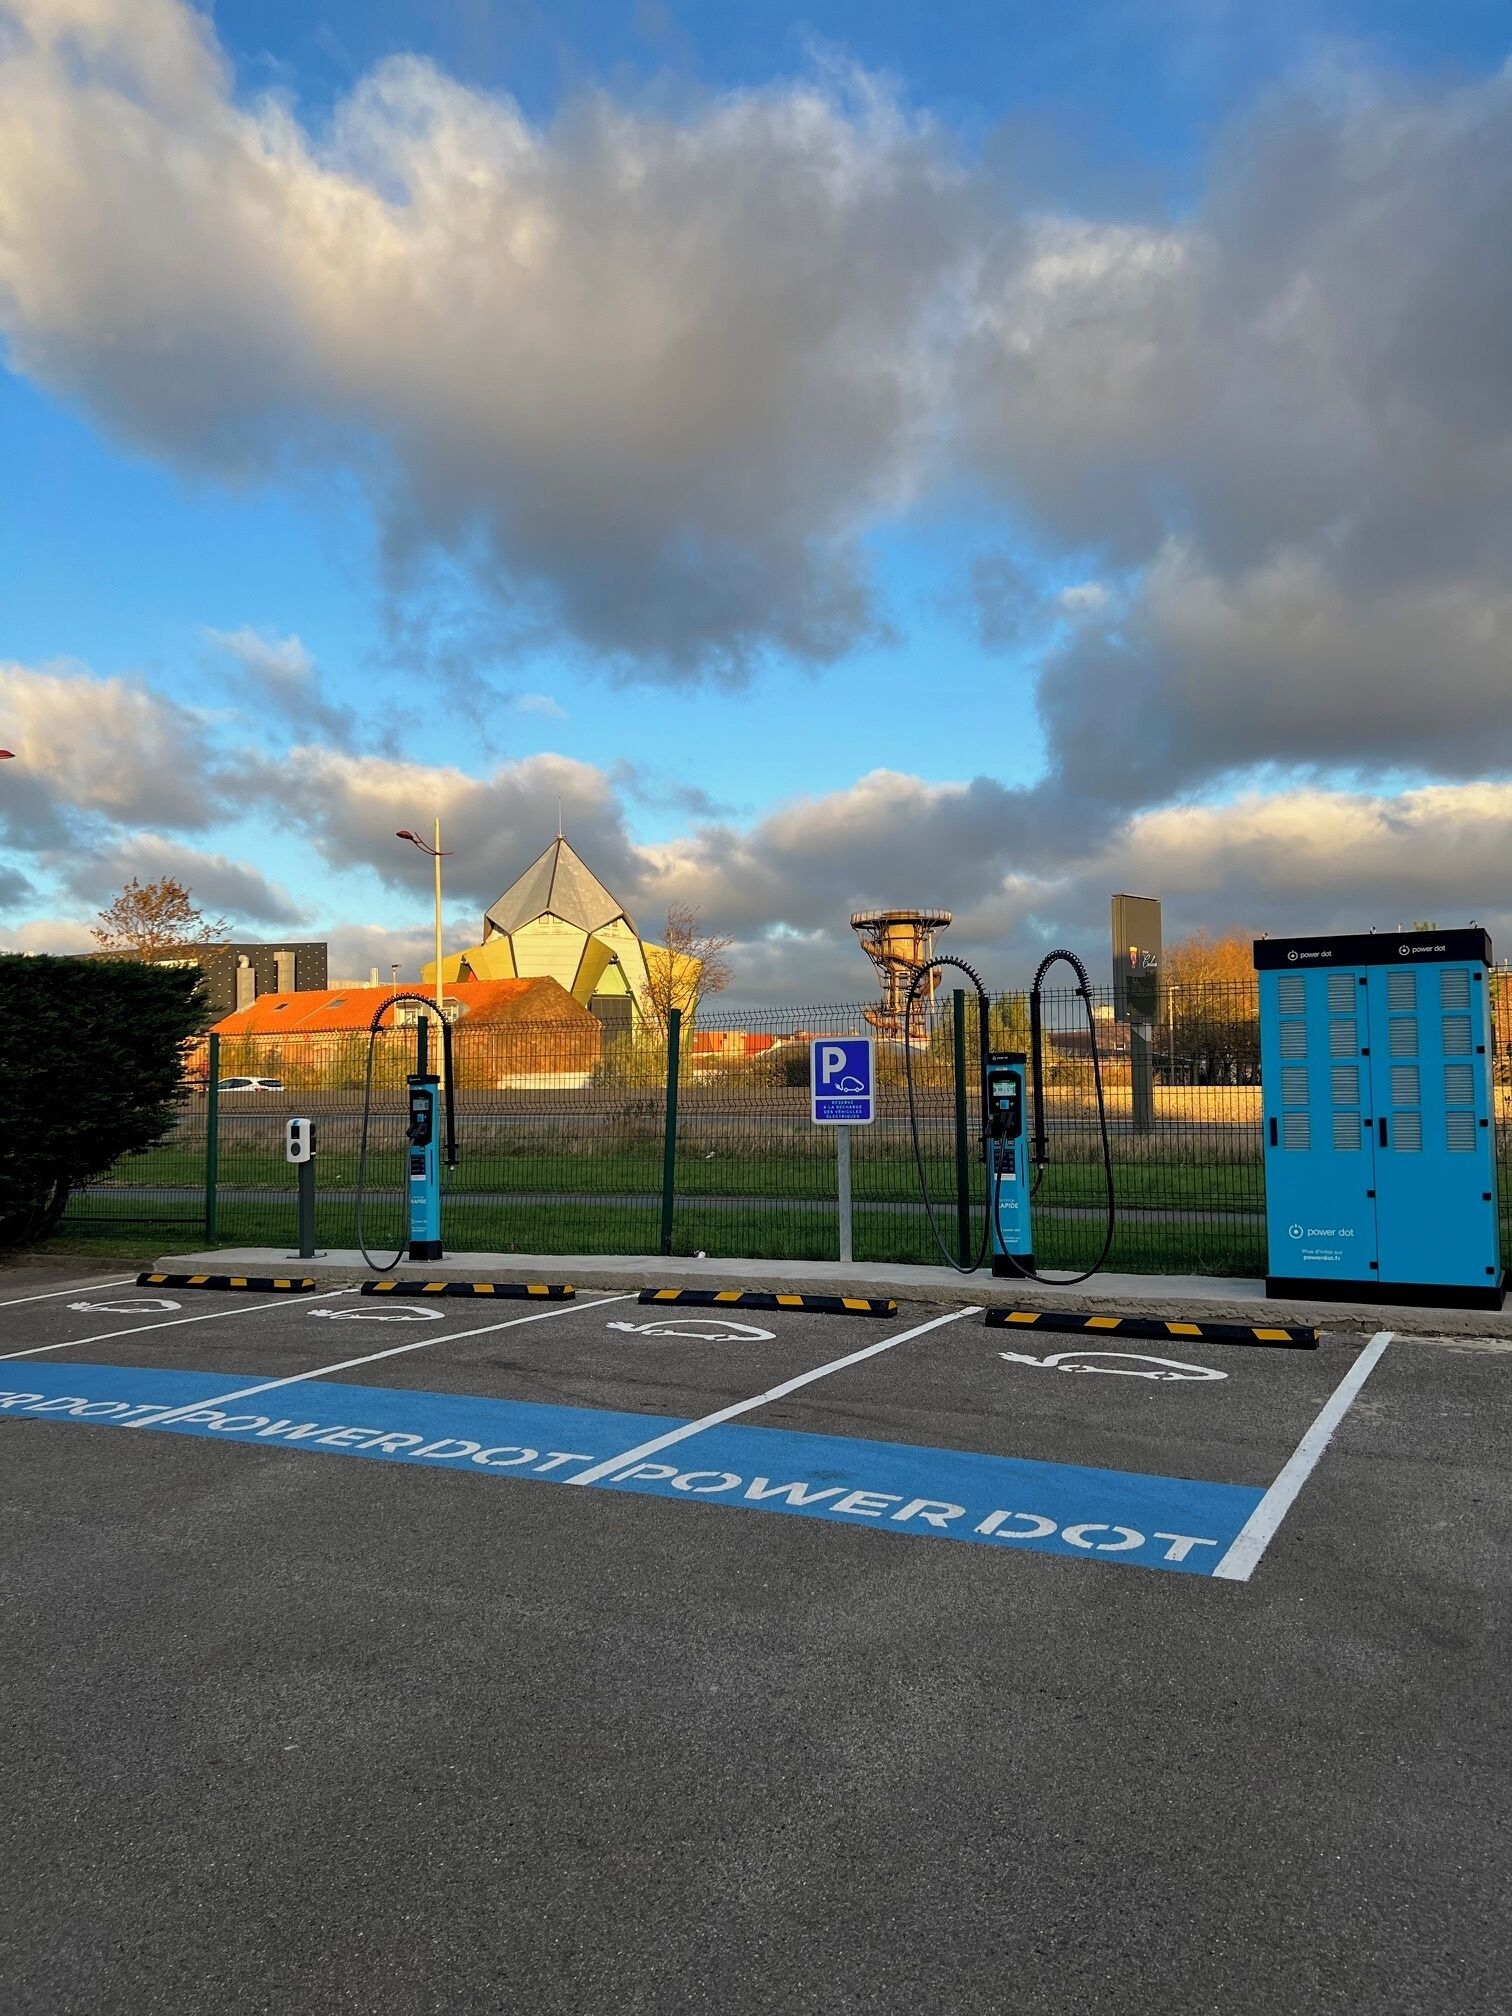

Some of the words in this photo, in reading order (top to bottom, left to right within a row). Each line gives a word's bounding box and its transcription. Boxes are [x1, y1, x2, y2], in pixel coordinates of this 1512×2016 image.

[1411, 946, 1433, 954] power
[1300, 951, 1320, 959] power
[823, 1046, 847, 1084] P
[1307, 1228, 1336, 1237] power
[1338, 1228, 1354, 1237] dot
